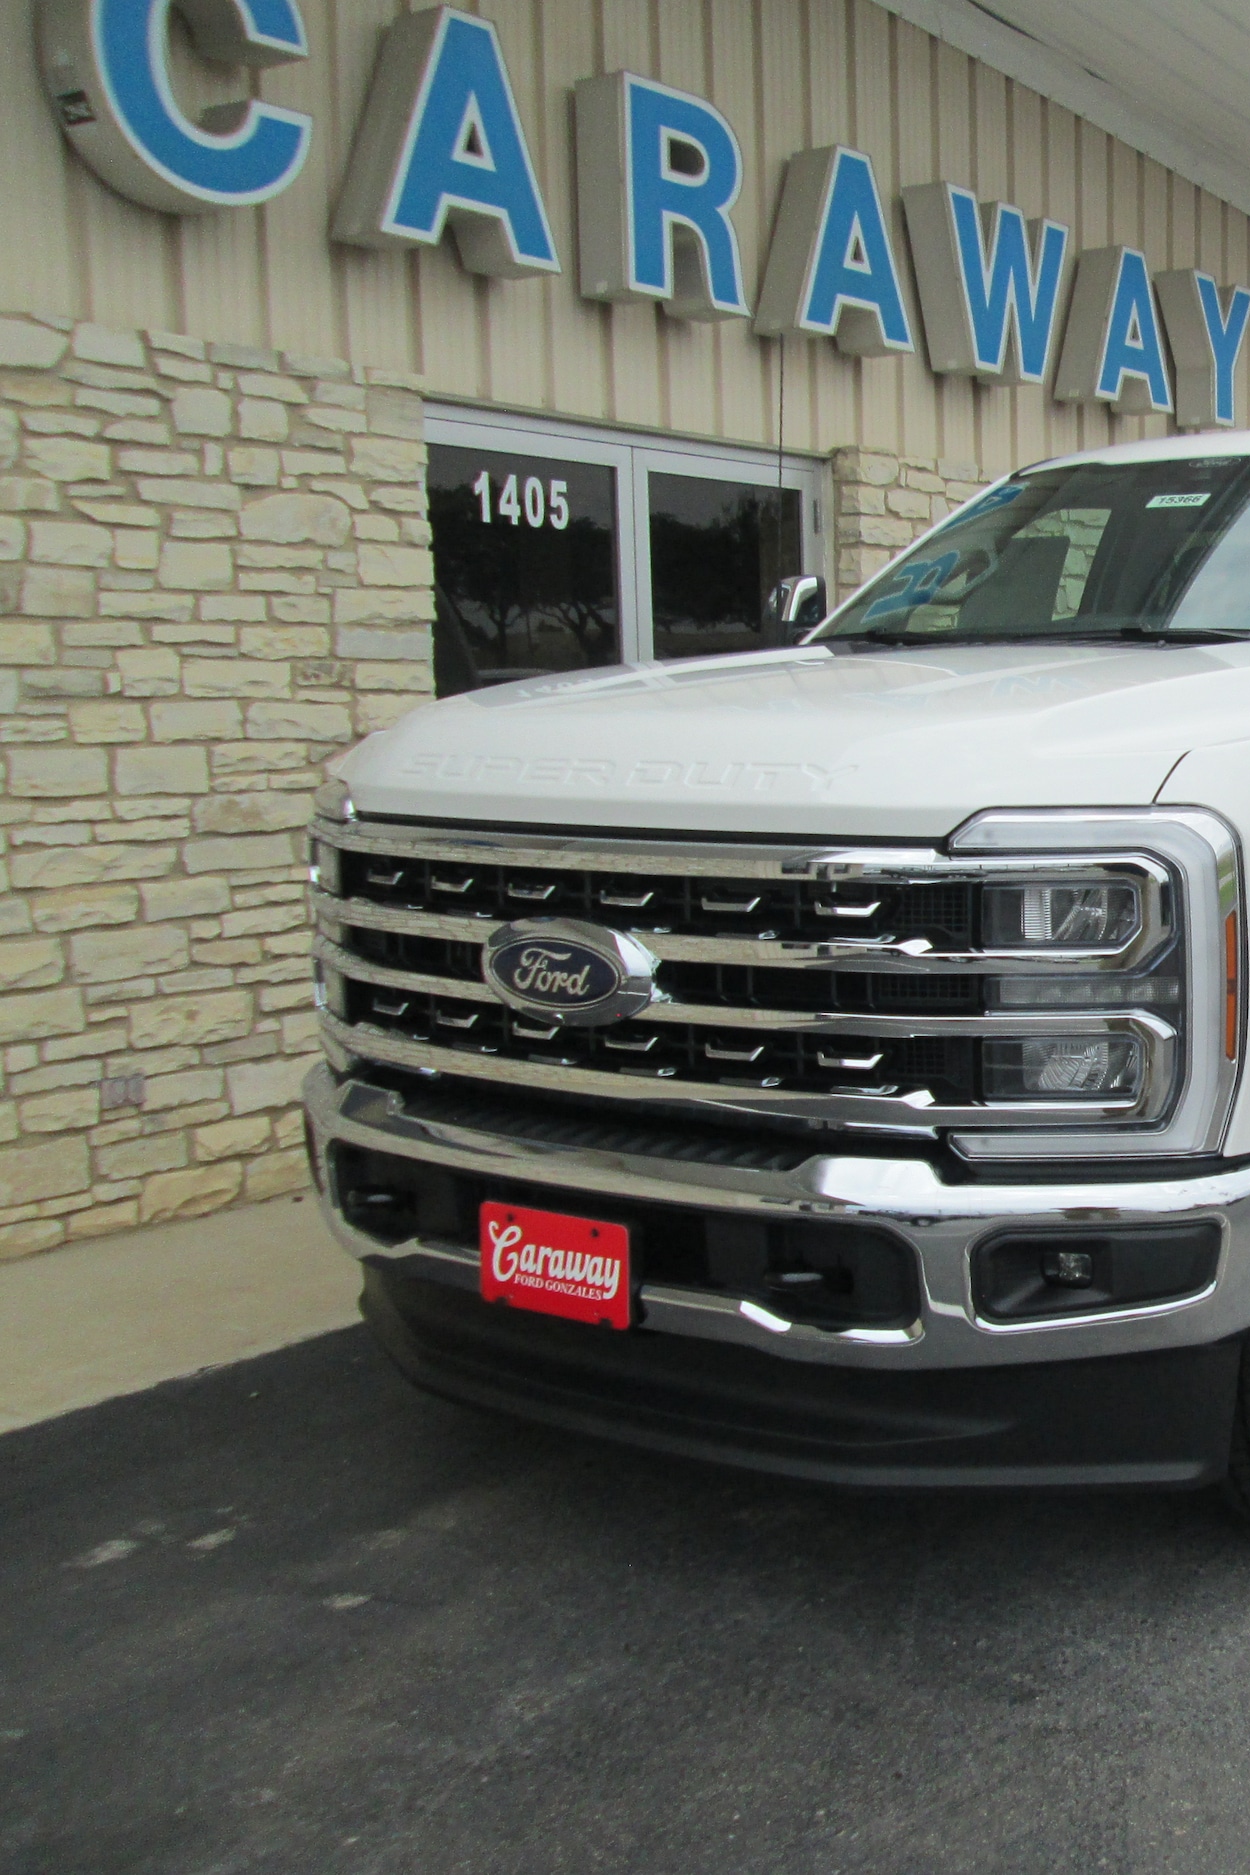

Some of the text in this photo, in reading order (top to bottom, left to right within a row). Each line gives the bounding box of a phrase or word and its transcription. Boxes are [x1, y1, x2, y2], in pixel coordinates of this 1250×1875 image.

[474, 471, 569, 530] 1405
[402, 753, 859, 791] SUPER DUTY
[514, 948, 591, 996] Ford
[488, 1221, 621, 1300] Caraway
[514, 1273, 603, 1301] FORD GONZALES
